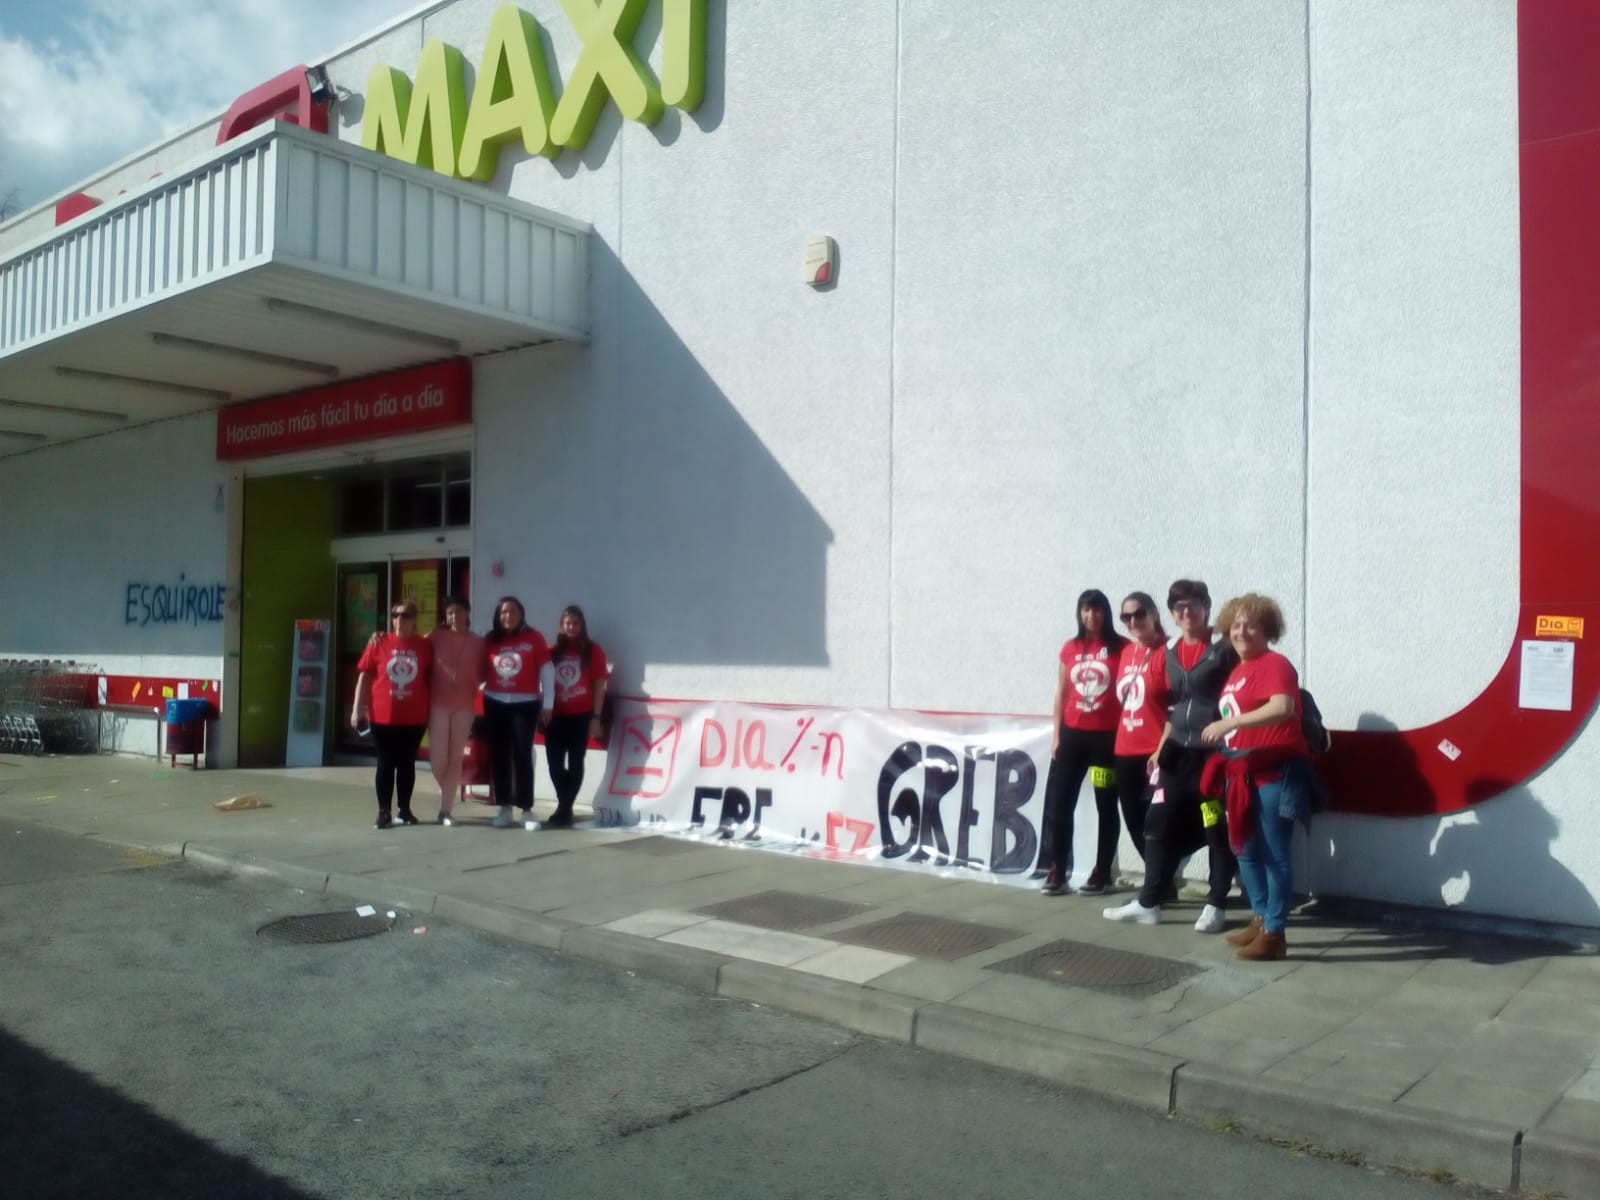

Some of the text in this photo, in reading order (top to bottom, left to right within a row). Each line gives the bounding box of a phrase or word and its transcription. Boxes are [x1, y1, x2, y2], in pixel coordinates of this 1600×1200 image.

[360, 0, 706, 181] MAXI
[225, 419, 285, 445] Hacemos
[288, 408, 317, 433] más
[320, 400, 350, 427] fácil
[353, 399, 369, 421] tu
[402, 395, 413, 412] a
